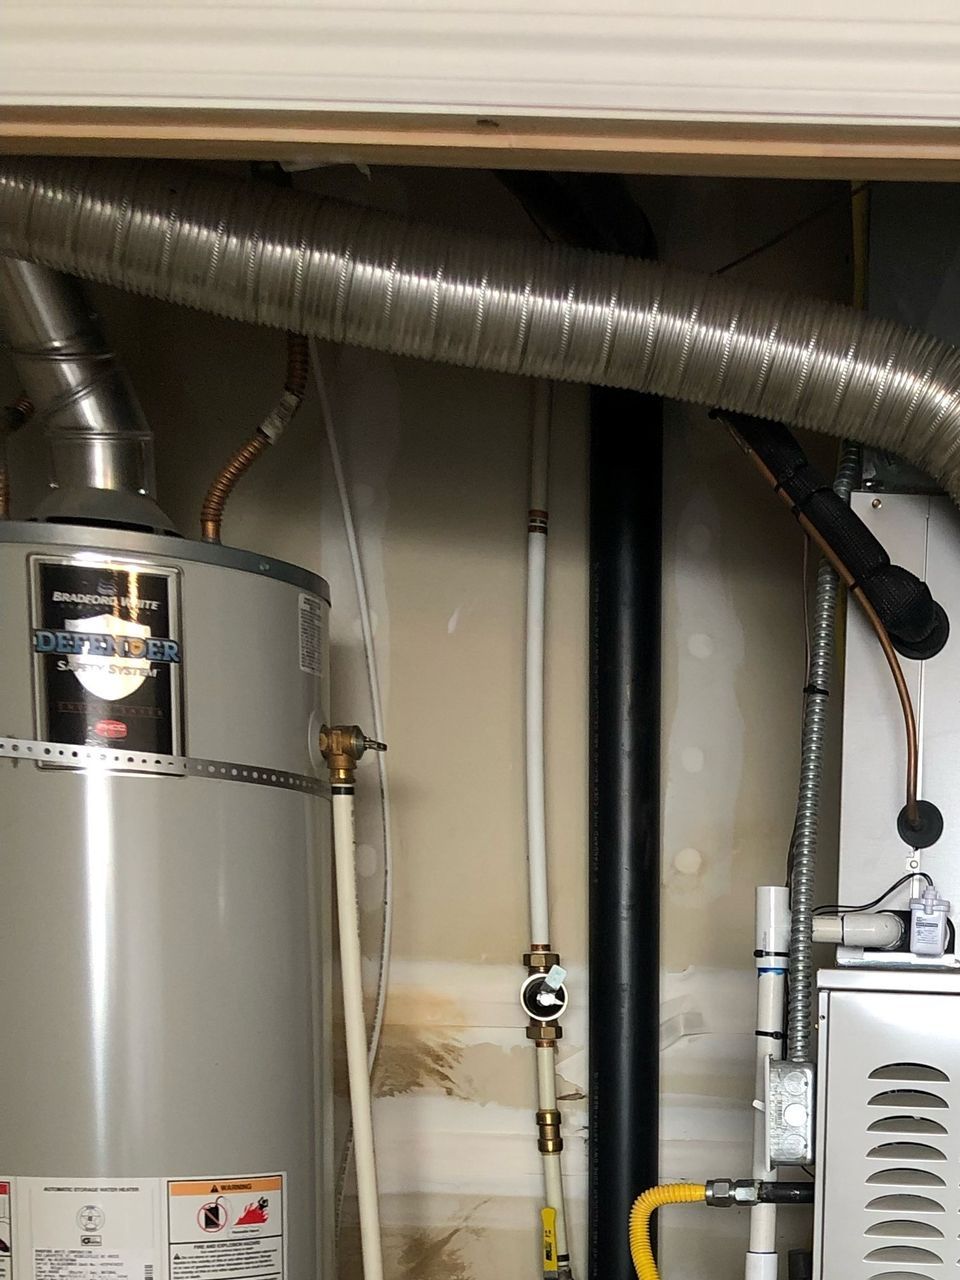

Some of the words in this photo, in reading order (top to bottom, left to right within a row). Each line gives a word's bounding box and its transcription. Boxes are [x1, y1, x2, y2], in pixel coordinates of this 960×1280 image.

[52, 591, 117, 605] BRADFORD
[120, 598, 161, 611] WITE
[34, 629, 181, 663] DEFENDER
[108, 664, 158, 678] SYSTEM
[221, 1183, 252, 1191] WARNING
